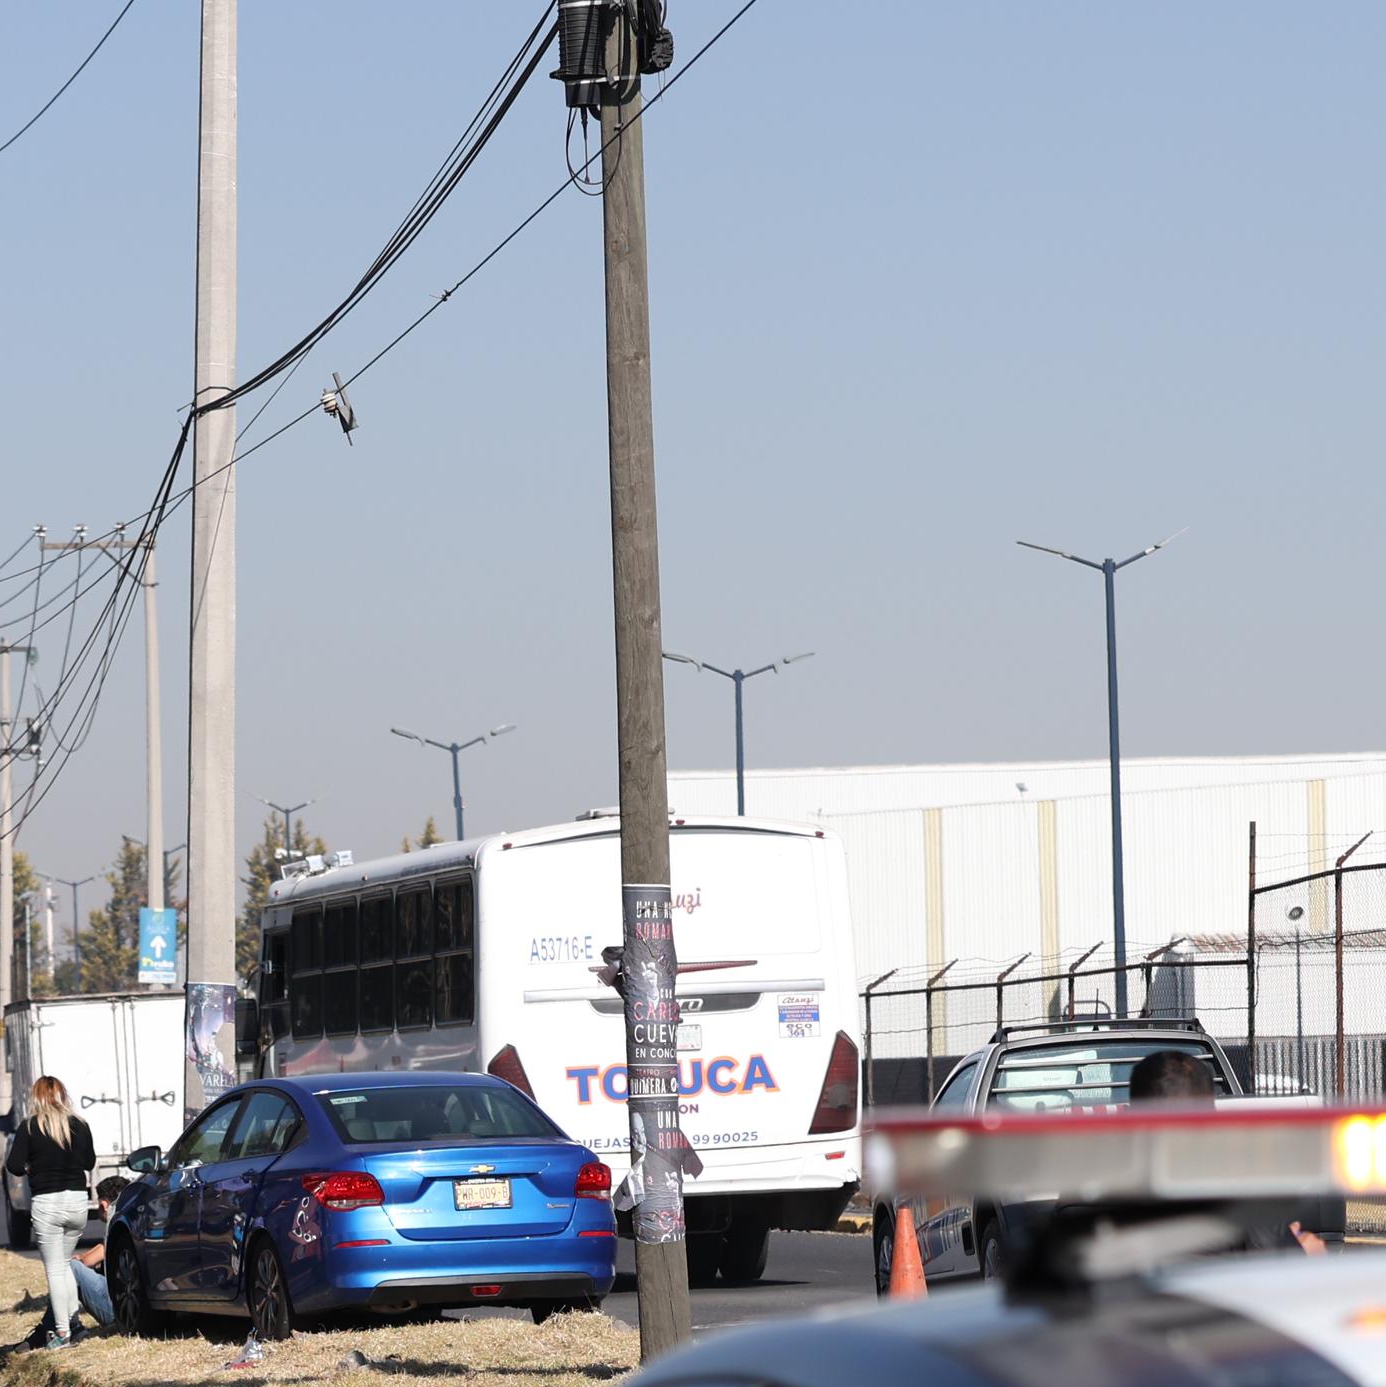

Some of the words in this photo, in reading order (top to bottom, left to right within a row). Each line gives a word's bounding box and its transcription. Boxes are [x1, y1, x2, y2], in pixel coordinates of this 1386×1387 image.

[636, 901, 658, 918] UNA
[530, 936, 593, 961] A53716-E
[634, 1024, 677, 1043] CUEV
[635, 1048, 646, 1058] EN
[650, 1048, 677, 1058] CONC
[565, 1053, 780, 1105] TOUCA
[657, 1110, 677, 1129] UNA
